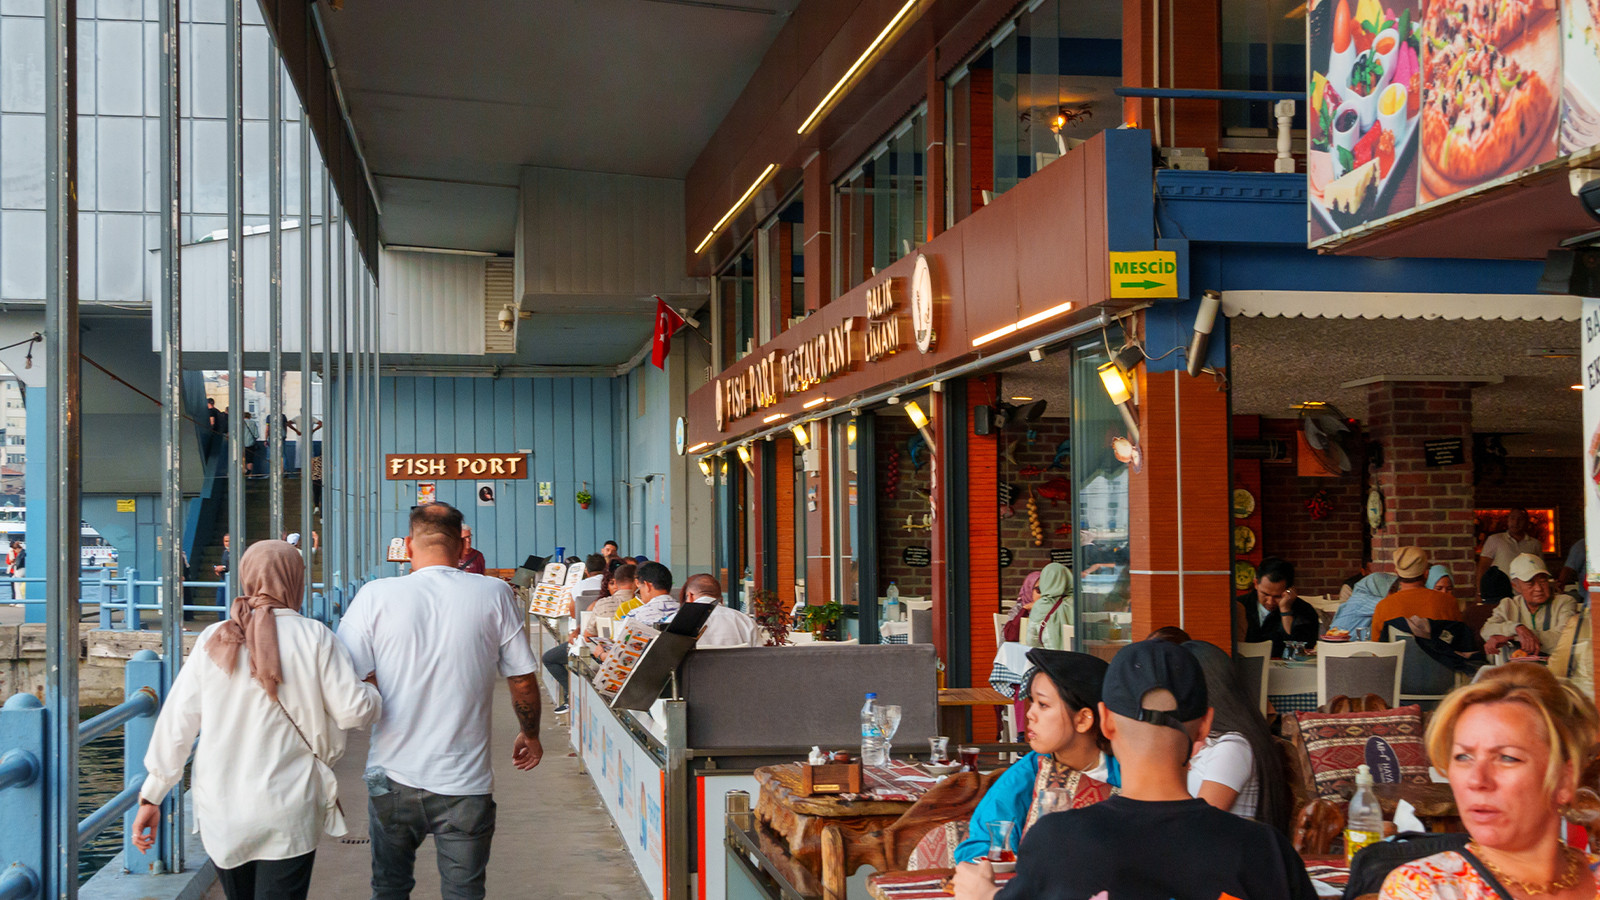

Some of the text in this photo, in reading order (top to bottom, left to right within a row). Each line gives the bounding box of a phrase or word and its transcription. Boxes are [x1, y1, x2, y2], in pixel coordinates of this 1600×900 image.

[1114, 258, 1176, 274] MESCİD
[866, 276, 893, 320] BALIK
[726, 374, 747, 418] FISH
[749, 351, 775, 408] PORT
[390, 457, 522, 476] FISH PORT
